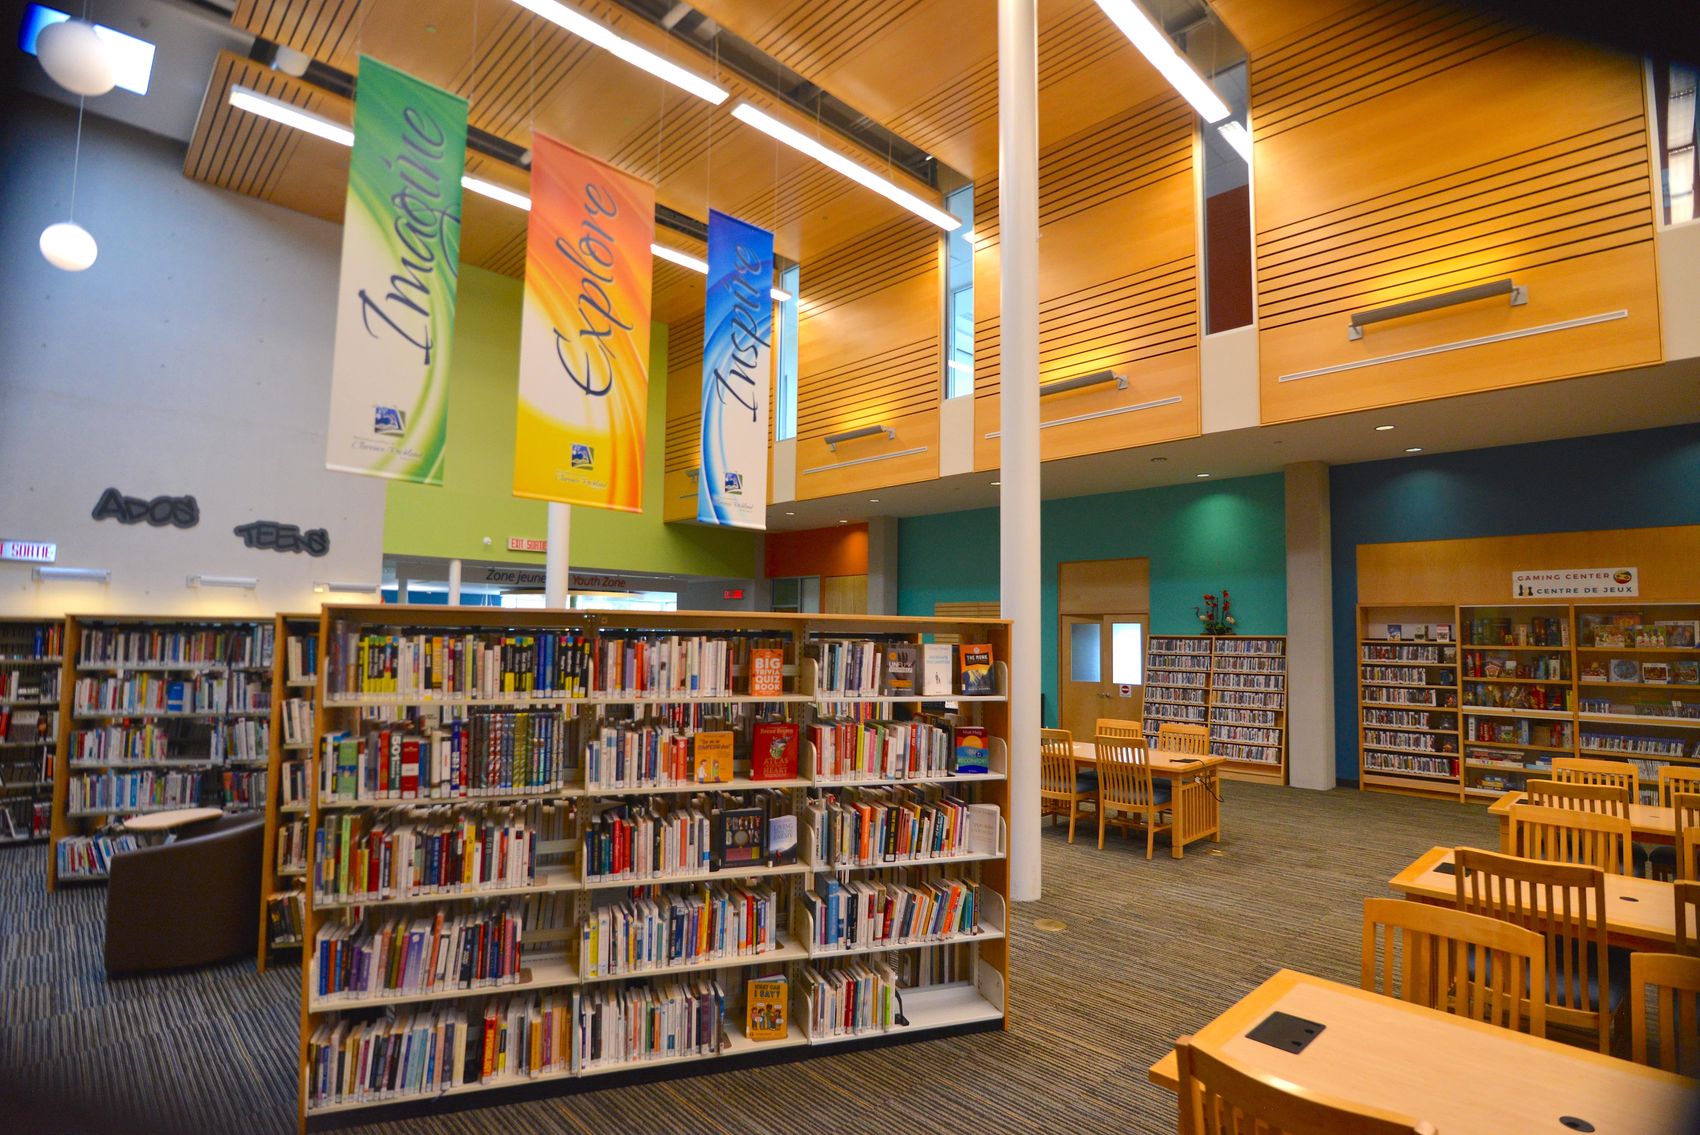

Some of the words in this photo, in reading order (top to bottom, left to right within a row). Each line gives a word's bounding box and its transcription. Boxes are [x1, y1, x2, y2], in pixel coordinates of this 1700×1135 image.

[358, 106, 461, 366] Imagine
[556, 182, 633, 397] Explore
[714, 244, 770, 423] Inspire
[92, 487, 199, 529] ADOS
[11, 543, 49, 558] SORTIE
[511, 538, 524, 548] EXIT
[486, 569, 515, 581] Zone
[573, 576, 600, 586] Youth
[602, 577, 626, 587] Zone
[1517, 573, 1561, 581] GAMING
[1565, 572, 1610, 580] CENTER
[755, 657, 780, 669] BIG
[755, 675, 780, 683] QUIZ
